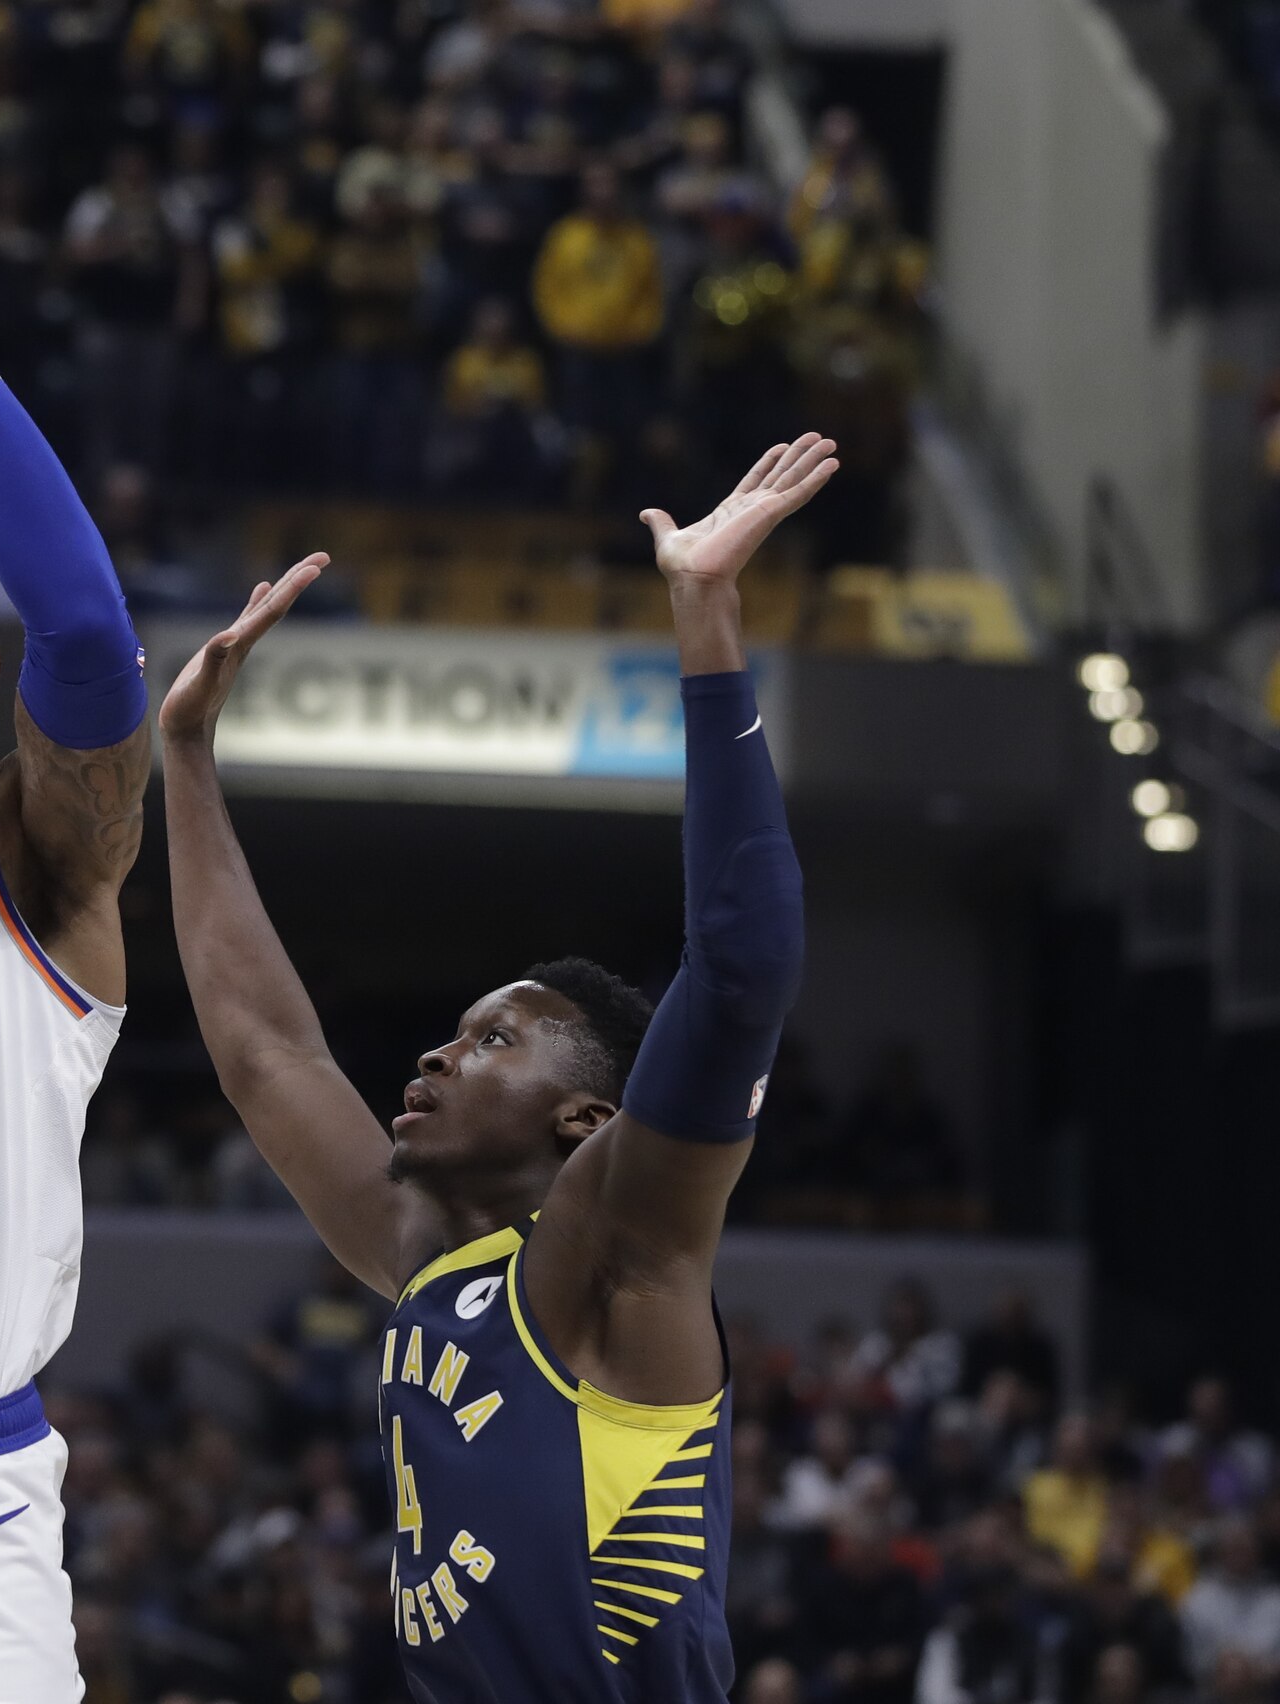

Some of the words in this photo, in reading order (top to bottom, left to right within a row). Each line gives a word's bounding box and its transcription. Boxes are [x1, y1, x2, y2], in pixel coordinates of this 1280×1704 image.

[221, 656, 576, 729] ECTION
[378, 1325, 504, 1443] IANA
[392, 1414, 423, 1555] 4
[391, 1529, 496, 1647] CERS
